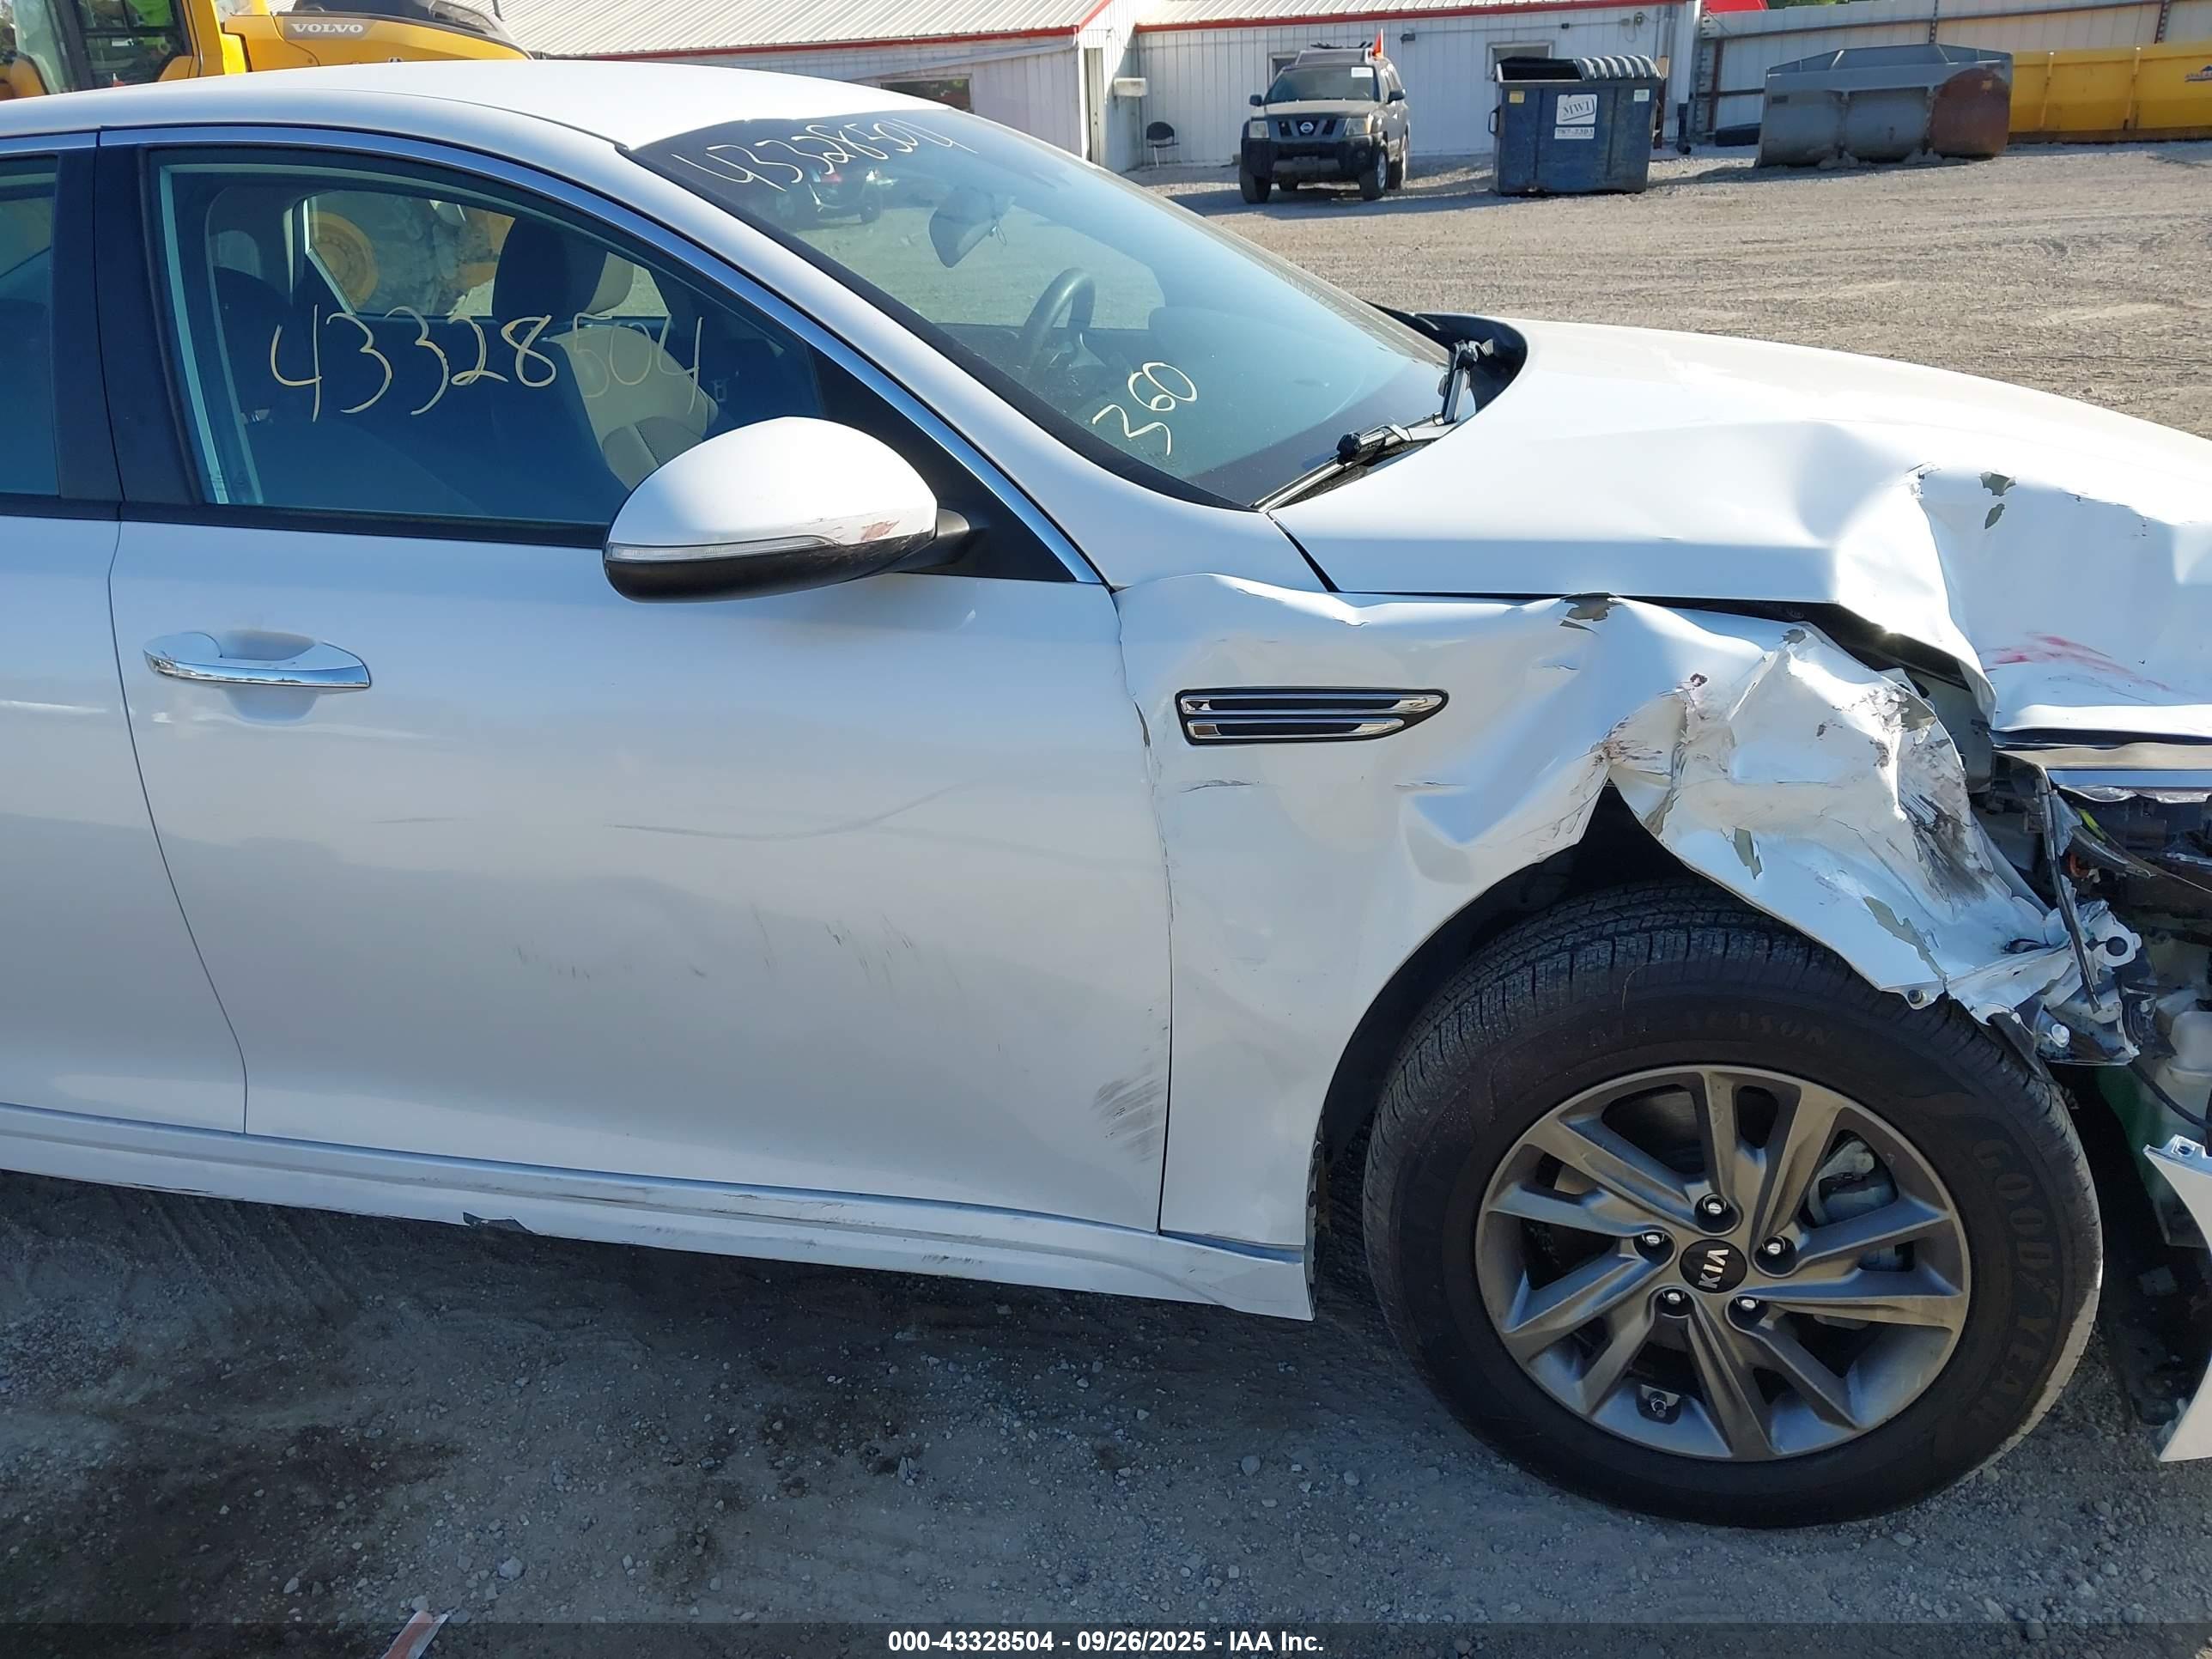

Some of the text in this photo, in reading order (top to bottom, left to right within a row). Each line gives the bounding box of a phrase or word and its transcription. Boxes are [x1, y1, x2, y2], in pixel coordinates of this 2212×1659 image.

[291, 23, 363, 33] VOLVO
[671, 118, 979, 191] 43328504
[270, 304, 704, 423] 43328504
[1091, 362, 1198, 456] 360
[1698, 1249, 1729, 1289] KIA
